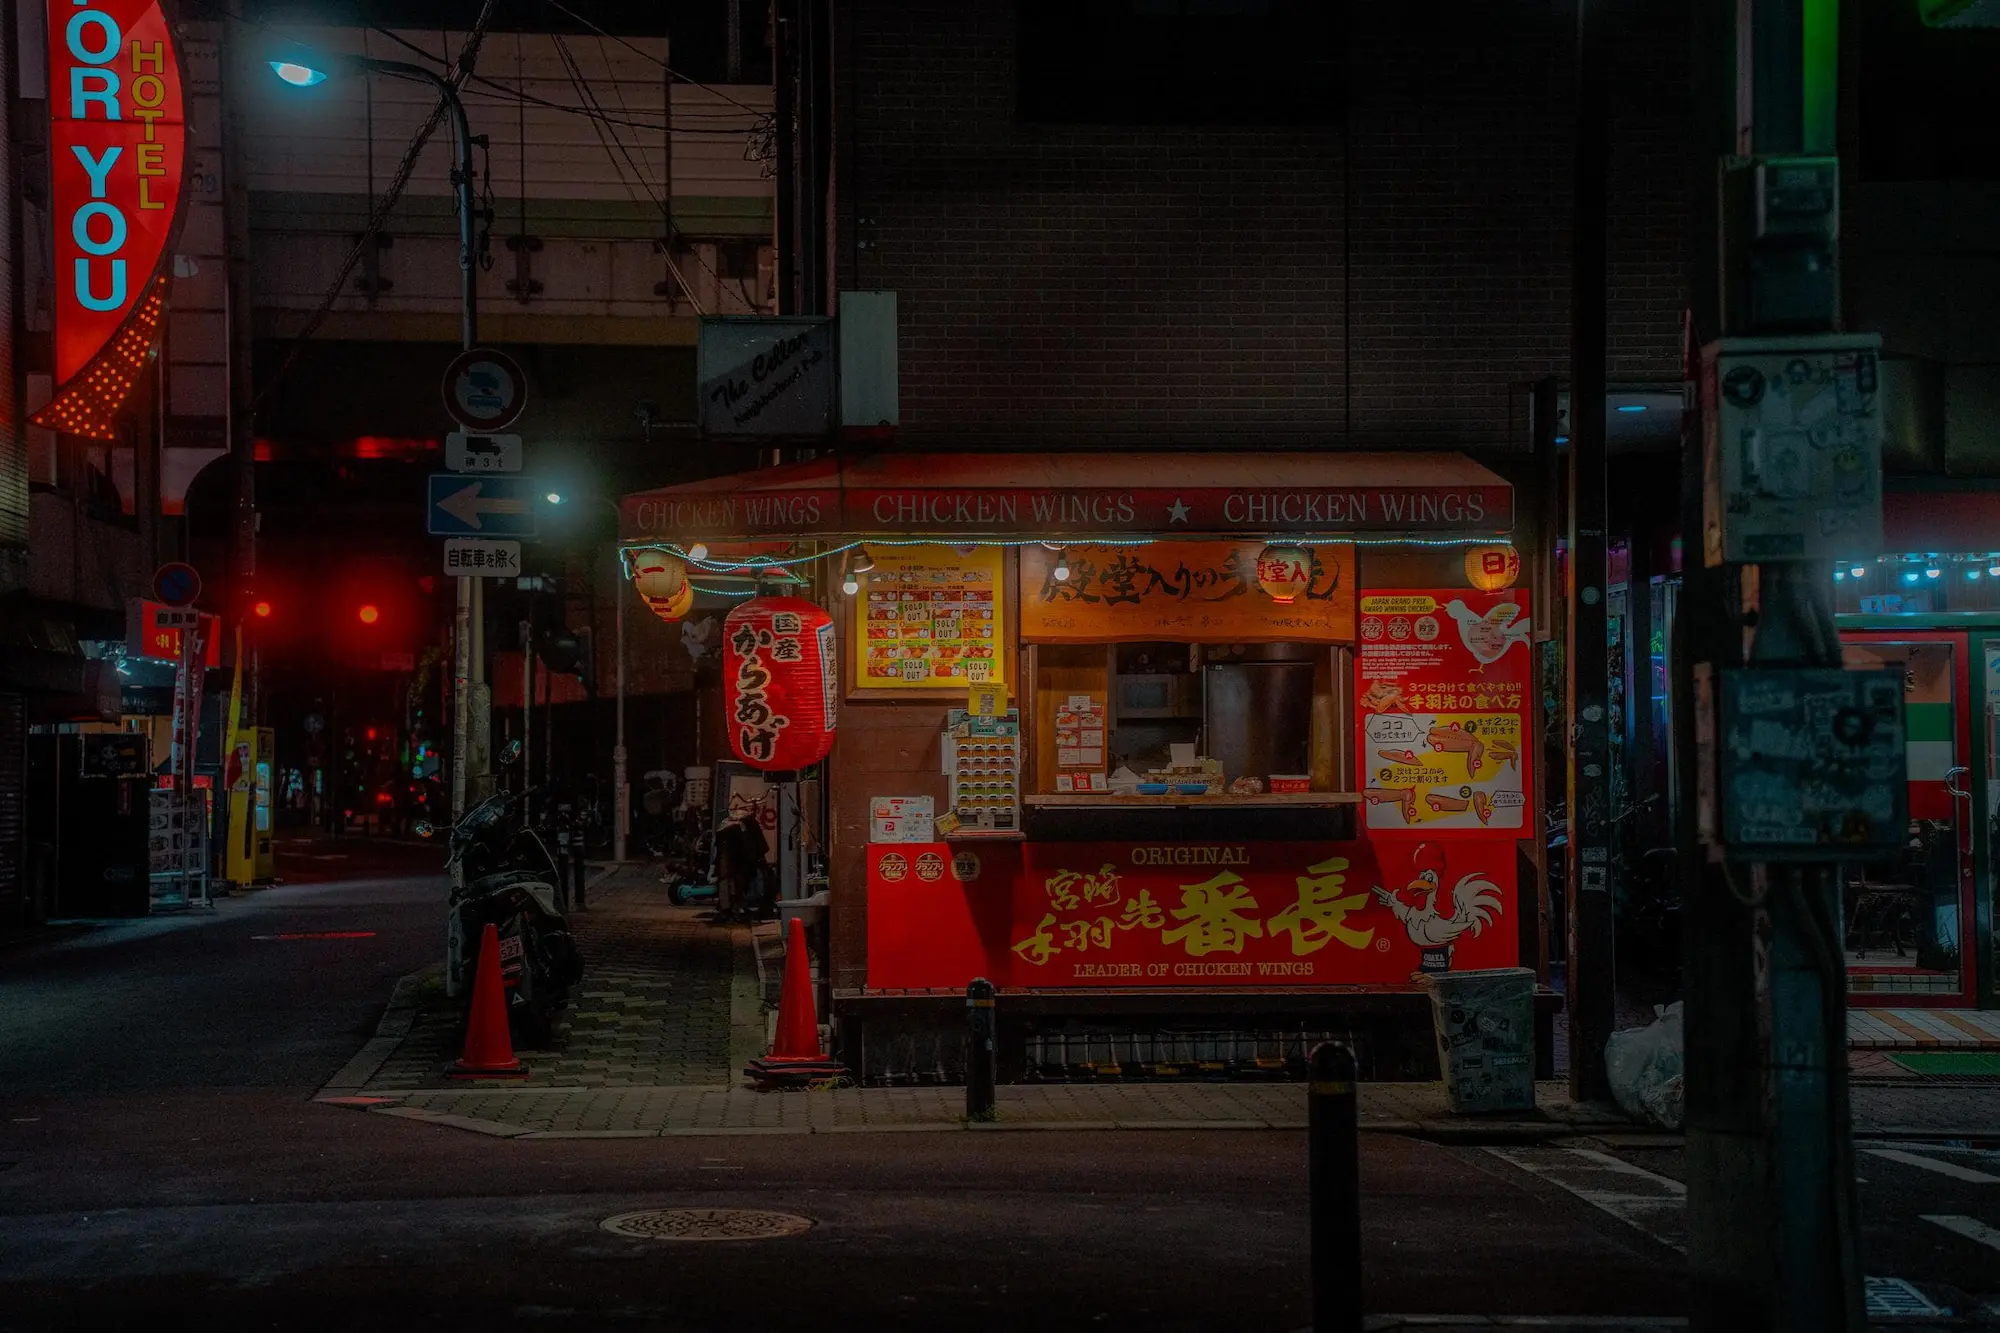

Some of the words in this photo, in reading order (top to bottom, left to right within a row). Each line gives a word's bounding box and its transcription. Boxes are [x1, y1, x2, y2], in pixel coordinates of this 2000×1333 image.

[65, 0, 123, 121] OR
[131, 40, 165, 210] HOTEL
[70, 145, 128, 311] YOU
[711, 379, 748, 409] The
[637, 499, 736, 530] CHICKEN
[745, 495, 821, 527] WINGS
[873, 495, 1018, 523] CHICKEN
[1031, 495, 1134, 523] WINGS
[1223, 493, 1367, 523] CHICKEN
[1378, 493, 1486, 523] WINGS
[448, 549, 517, 568] 自転車を除く
[904, 603, 923, 611] SOLD
[907, 612, 921, 621] OUT
[936, 620, 956, 628] SOLD
[774, 613, 801, 661] 国産
[938, 629, 953, 638] OUT
[904, 661, 923, 669] SOLD
[968, 662, 988, 670] SOLD
[906, 671, 920, 680] OUT
[970, 672, 985, 680] OUT
[732, 624, 787, 761] からあげ
[1408, 693, 1522, 709] 手羽先の食べ方
[1382, 720, 1403, 729] ココ
[1477, 717, 1519, 726] まず2つに
[1131, 847, 1250, 865] ORIGINAL
[879, 862, 907, 871] グランプリ
[915, 862, 943, 871] グランプリ
[1045, 864, 1124, 911] 宮崎
[1161, 857, 1375, 956] 番長
[1011, 889, 1167, 966] 手羽先
[1073, 964, 1143, 977] LEADER
[1147, 964, 1169, 977] OF
[1173, 963, 1252, 977] CHICKEN
[1257, 963, 1315, 977] WINGS
